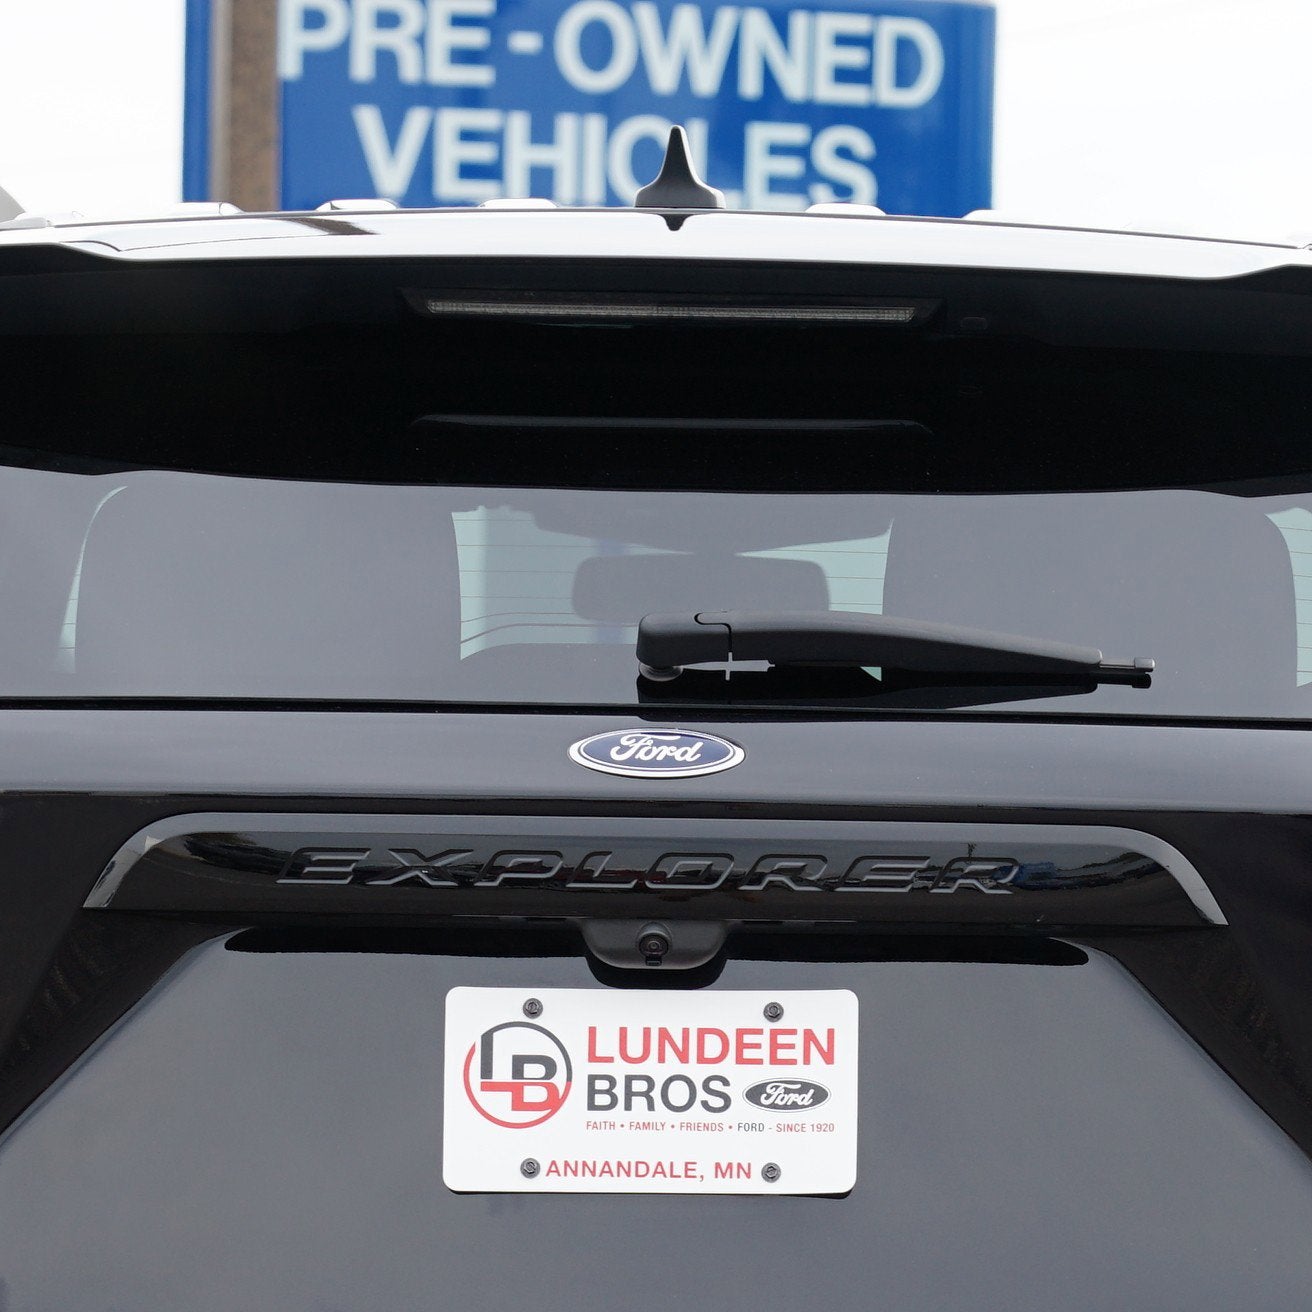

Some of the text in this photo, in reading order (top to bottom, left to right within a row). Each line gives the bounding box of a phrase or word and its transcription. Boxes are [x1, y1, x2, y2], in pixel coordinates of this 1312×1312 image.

[278, 0, 945, 109] PRE-OWNED
[609, 733, 703, 765] Ford
[276, 846, 1023, 896] EXPLORER
[586, 1025, 836, 1066] LUNDEEN
[586, 1074, 815, 1114] BROS Ford
[585, 1121, 617, 1132] FAITH
[628, 1121, 667, 1132] FAMILY
[679, 1122, 725, 1133] FRIENDS
[737, 1122, 766, 1133] FORD
[776, 1123, 807, 1133] SINCE
[810, 1123, 836, 1133] 1920
[545, 1159, 753, 1181] ANNANDALE, MN
